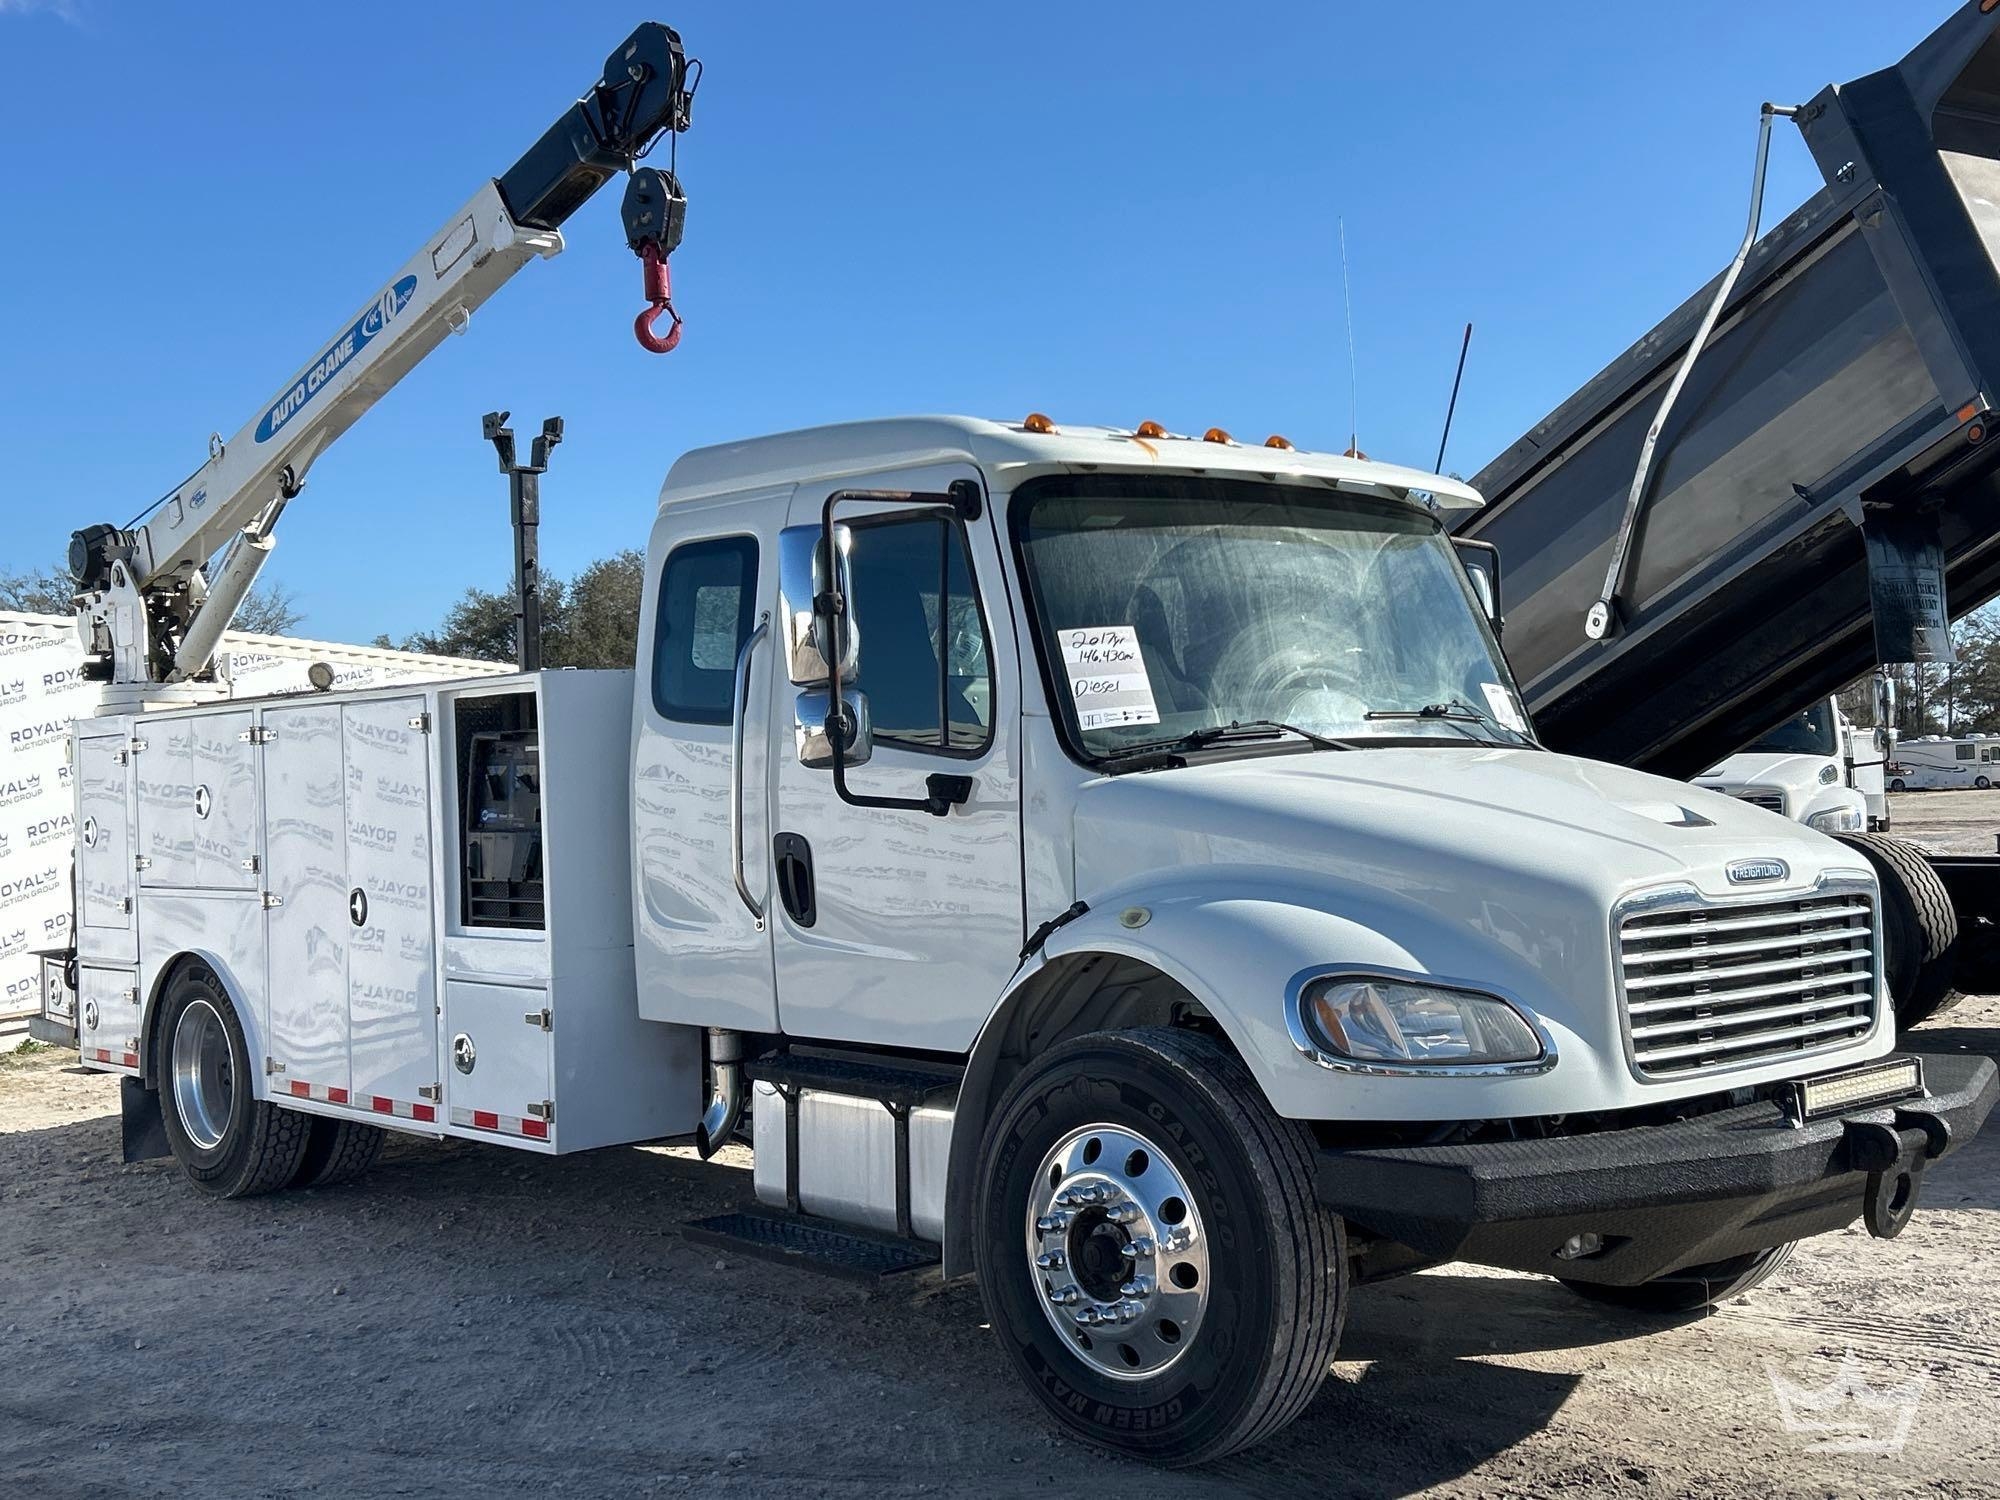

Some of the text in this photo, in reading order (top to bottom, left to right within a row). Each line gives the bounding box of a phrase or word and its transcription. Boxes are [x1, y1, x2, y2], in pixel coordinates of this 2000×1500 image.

[378, 287, 397, 328] 10
[271, 382, 306, 431] AUTO
[35, 637, 67, 649] GROUP
[43, 668, 83, 686] ROYA
[233, 665, 260, 675] UCTION
[45, 682, 80, 696] AUCTION
[1075, 679, 1120, 698] Diesel
[10, 720, 63, 743] ROYAL
[13, 737, 50, 753] AUCTION
[14, 788, 43, 803] GROUP
[30, 831, 66, 848] AUCTION
[1735, 864, 1782, 878] FREIGHTLINER
[31, 881, 60, 897] GROUP
[6, 973, 40, 996] ROY
[1037, 1363, 1184, 1430] GREEN MAX
